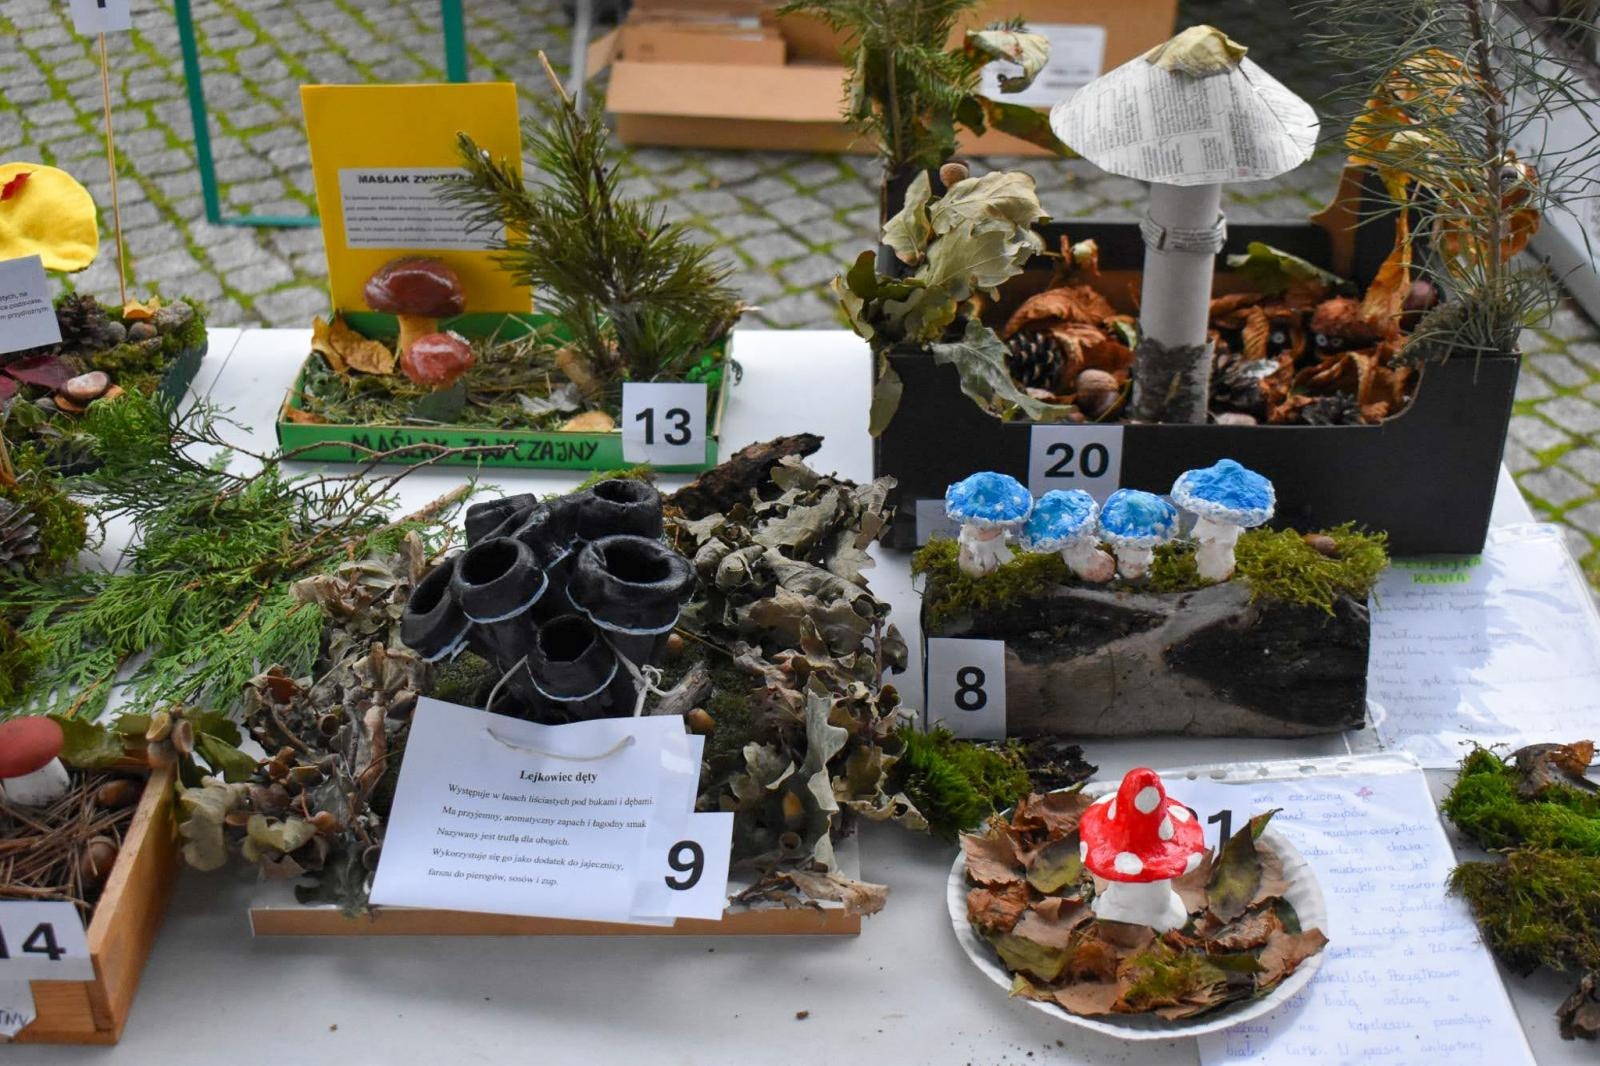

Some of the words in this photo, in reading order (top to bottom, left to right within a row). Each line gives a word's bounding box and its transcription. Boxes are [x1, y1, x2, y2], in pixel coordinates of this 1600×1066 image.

[635, 407, 692, 446] 13
[1044, 442, 1110, 478] 20
[954, 666, 987, 711] 8
[520, 770, 572, 783] Lejkowiec
[575, 772, 597, 784] dęty
[448, 784, 490, 798] Występuje
[502, 793, 527, 803] lasach
[529, 796, 570, 806] liściastych
[571, 798, 588, 807] pod
[589, 798, 617, 806] bukami
[442, 806, 456, 816] Ma
[457, 809, 502, 822] przyjemny,
[504, 815, 555, 826] aromatyczny
[557, 819, 586, 828] zapach
[593, 820, 624, 830] łagodny
[627, 820, 647, 828] smak
[437, 828, 478, 840] Nazywany
[479, 833, 496, 841] jest
[498, 834, 519, 843] truflą
[521, 835, 533, 843] dla
[536, 837, 569, 847] ubogich.
[433, 848, 487, 860] Wykorzystuje
[489, 854, 500, 864] się
[514, 855, 532, 864] jako
[533, 857, 565, 866] dodatek
[579, 860, 625, 872] jajecznicy,
[665, 840, 705, 890] 9
[428, 869, 452, 877] farszu
[466, 873, 506, 883] pierogów,
[508, 875, 533, 883] sosów
[541, 878, 559, 887] zup.
